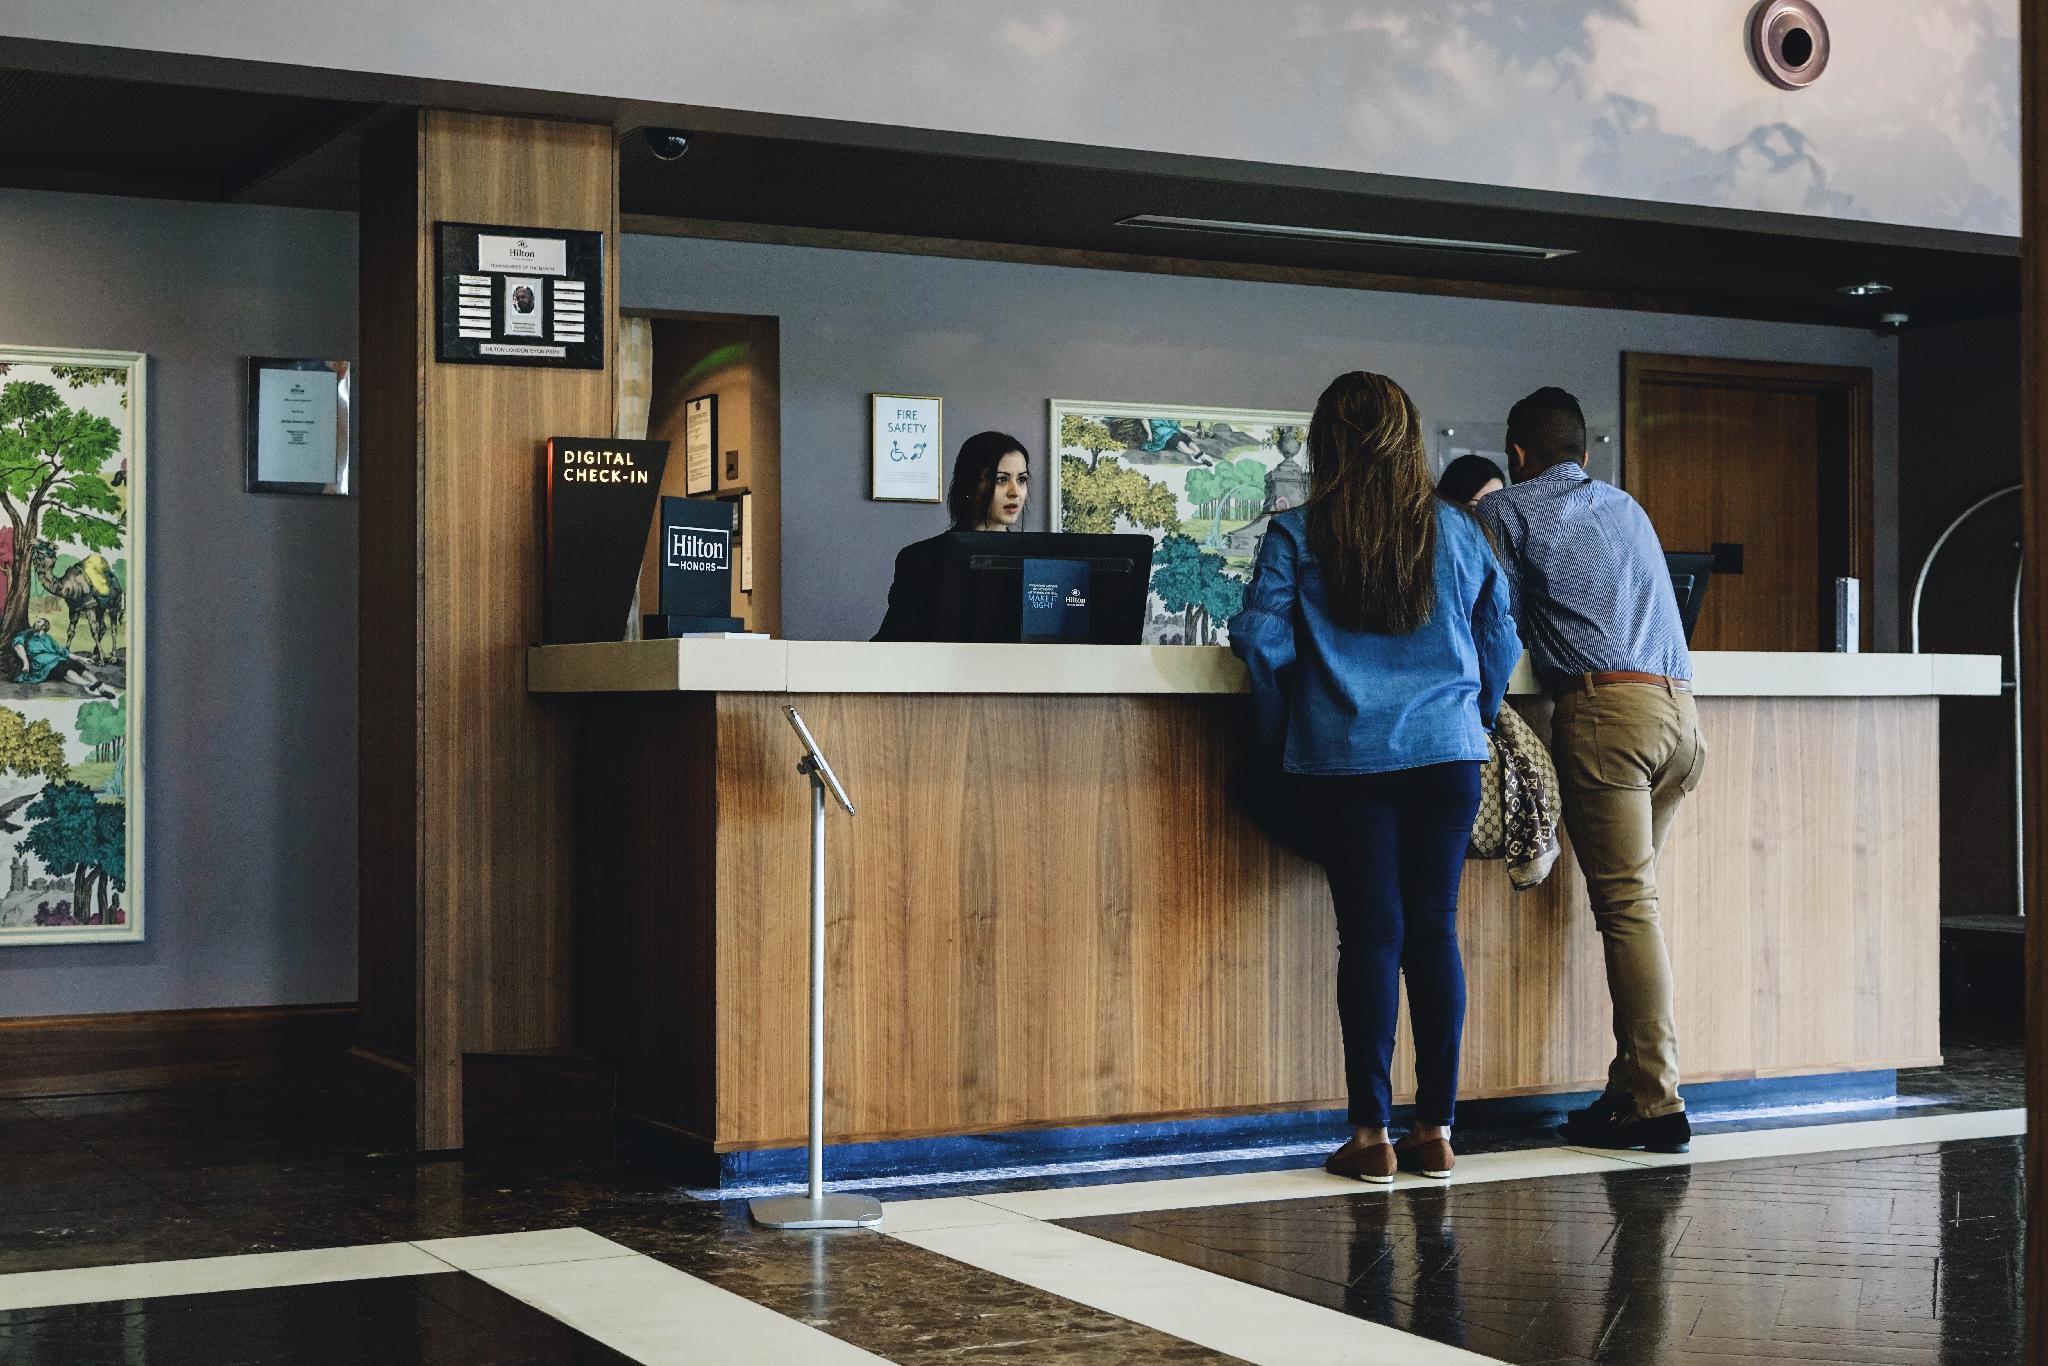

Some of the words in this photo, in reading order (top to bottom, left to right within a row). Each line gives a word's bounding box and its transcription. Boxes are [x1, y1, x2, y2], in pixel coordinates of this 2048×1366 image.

[509, 248, 535, 258] Hilton
[896, 409, 918, 421] FIRE
[887, 423, 927, 434] SAFETY
[564, 450, 634, 465] DIGITAL
[563, 468, 648, 484] CHECK-IN
[672, 533, 724, 559] Hilton
[680, 560, 717, 572] HONORS
[1065, 596, 1086, 604] Hilton
